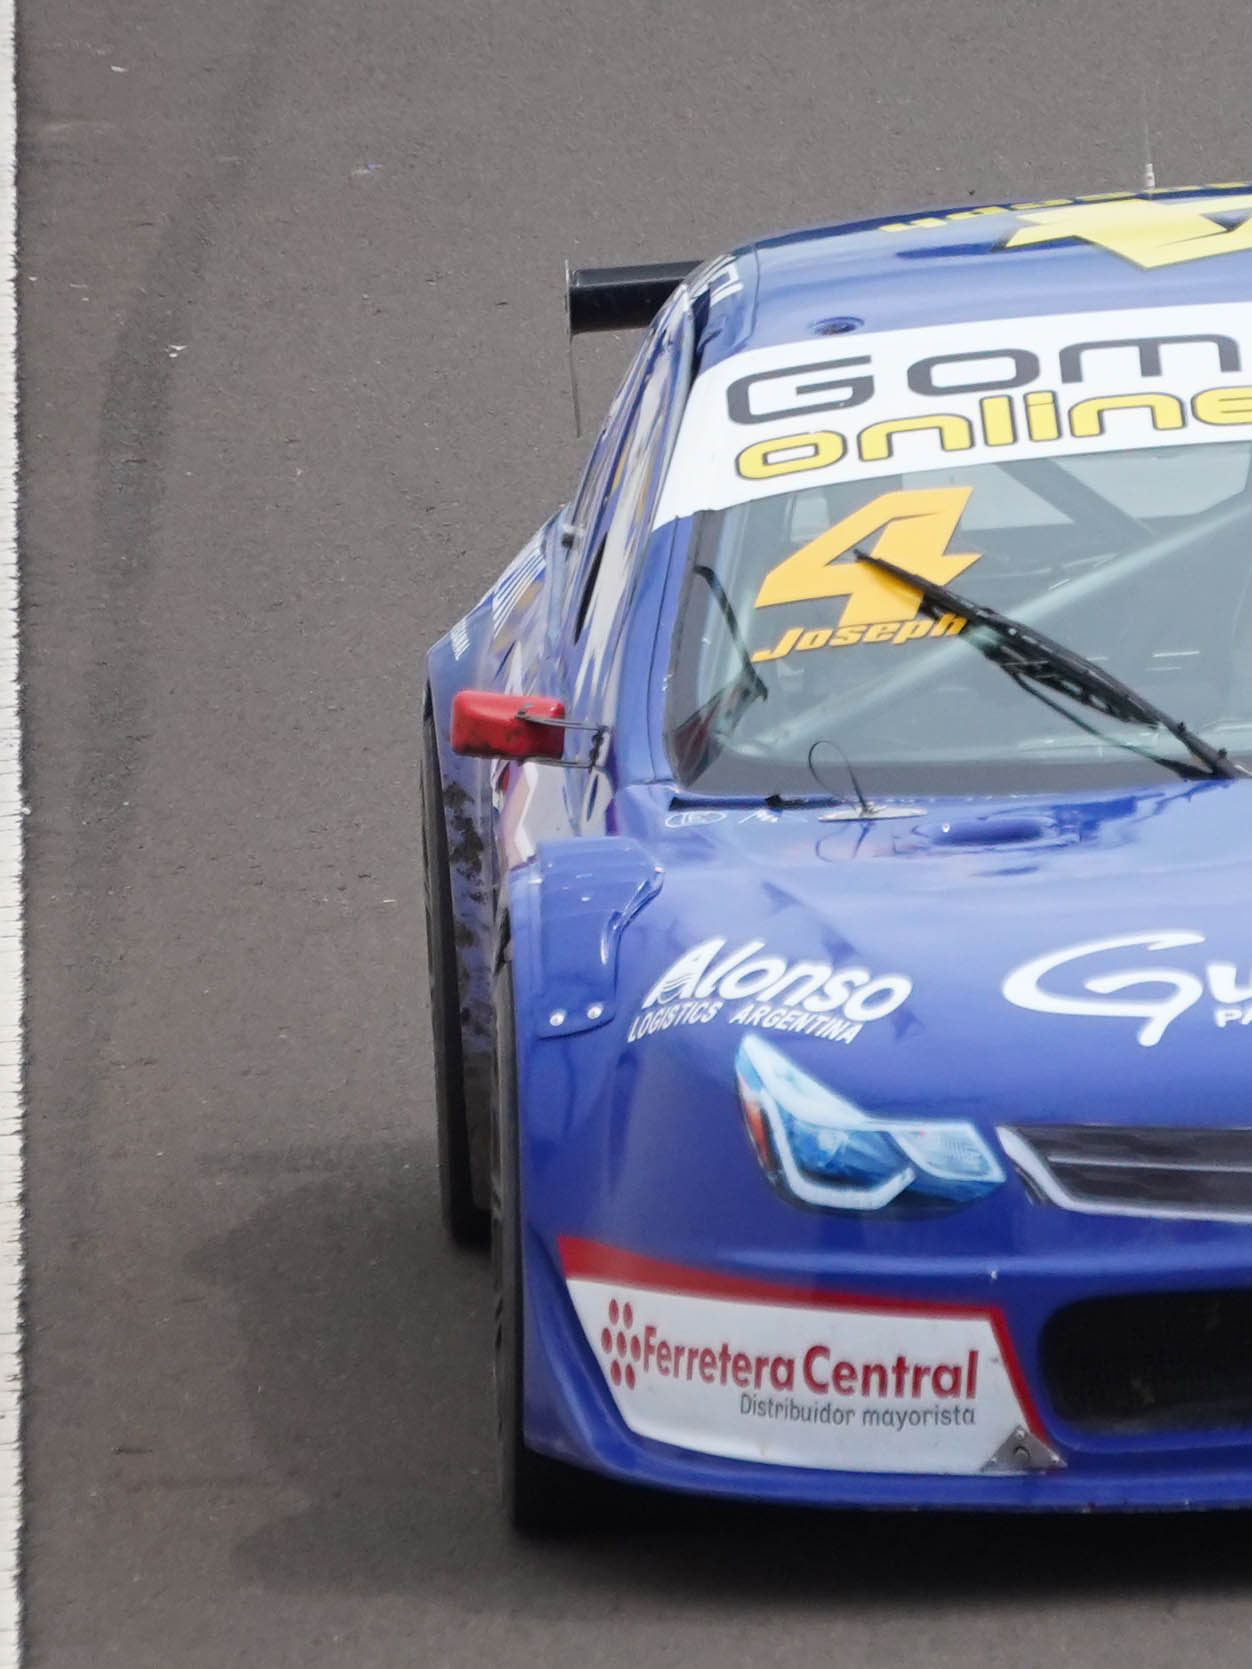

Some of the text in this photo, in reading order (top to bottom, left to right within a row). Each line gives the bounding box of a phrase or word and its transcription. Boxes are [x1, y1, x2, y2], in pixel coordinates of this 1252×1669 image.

[754, 486, 984, 627] 4
[751, 612, 969, 662] Joseph
[641, 937, 912, 1023] Alonso
[626, 1001, 864, 1044] LOGISTICS ARGENTINA
[643, 1325, 979, 1399] Ferretera Central
[740, 1395, 976, 1432] Distribuidor mayorista
